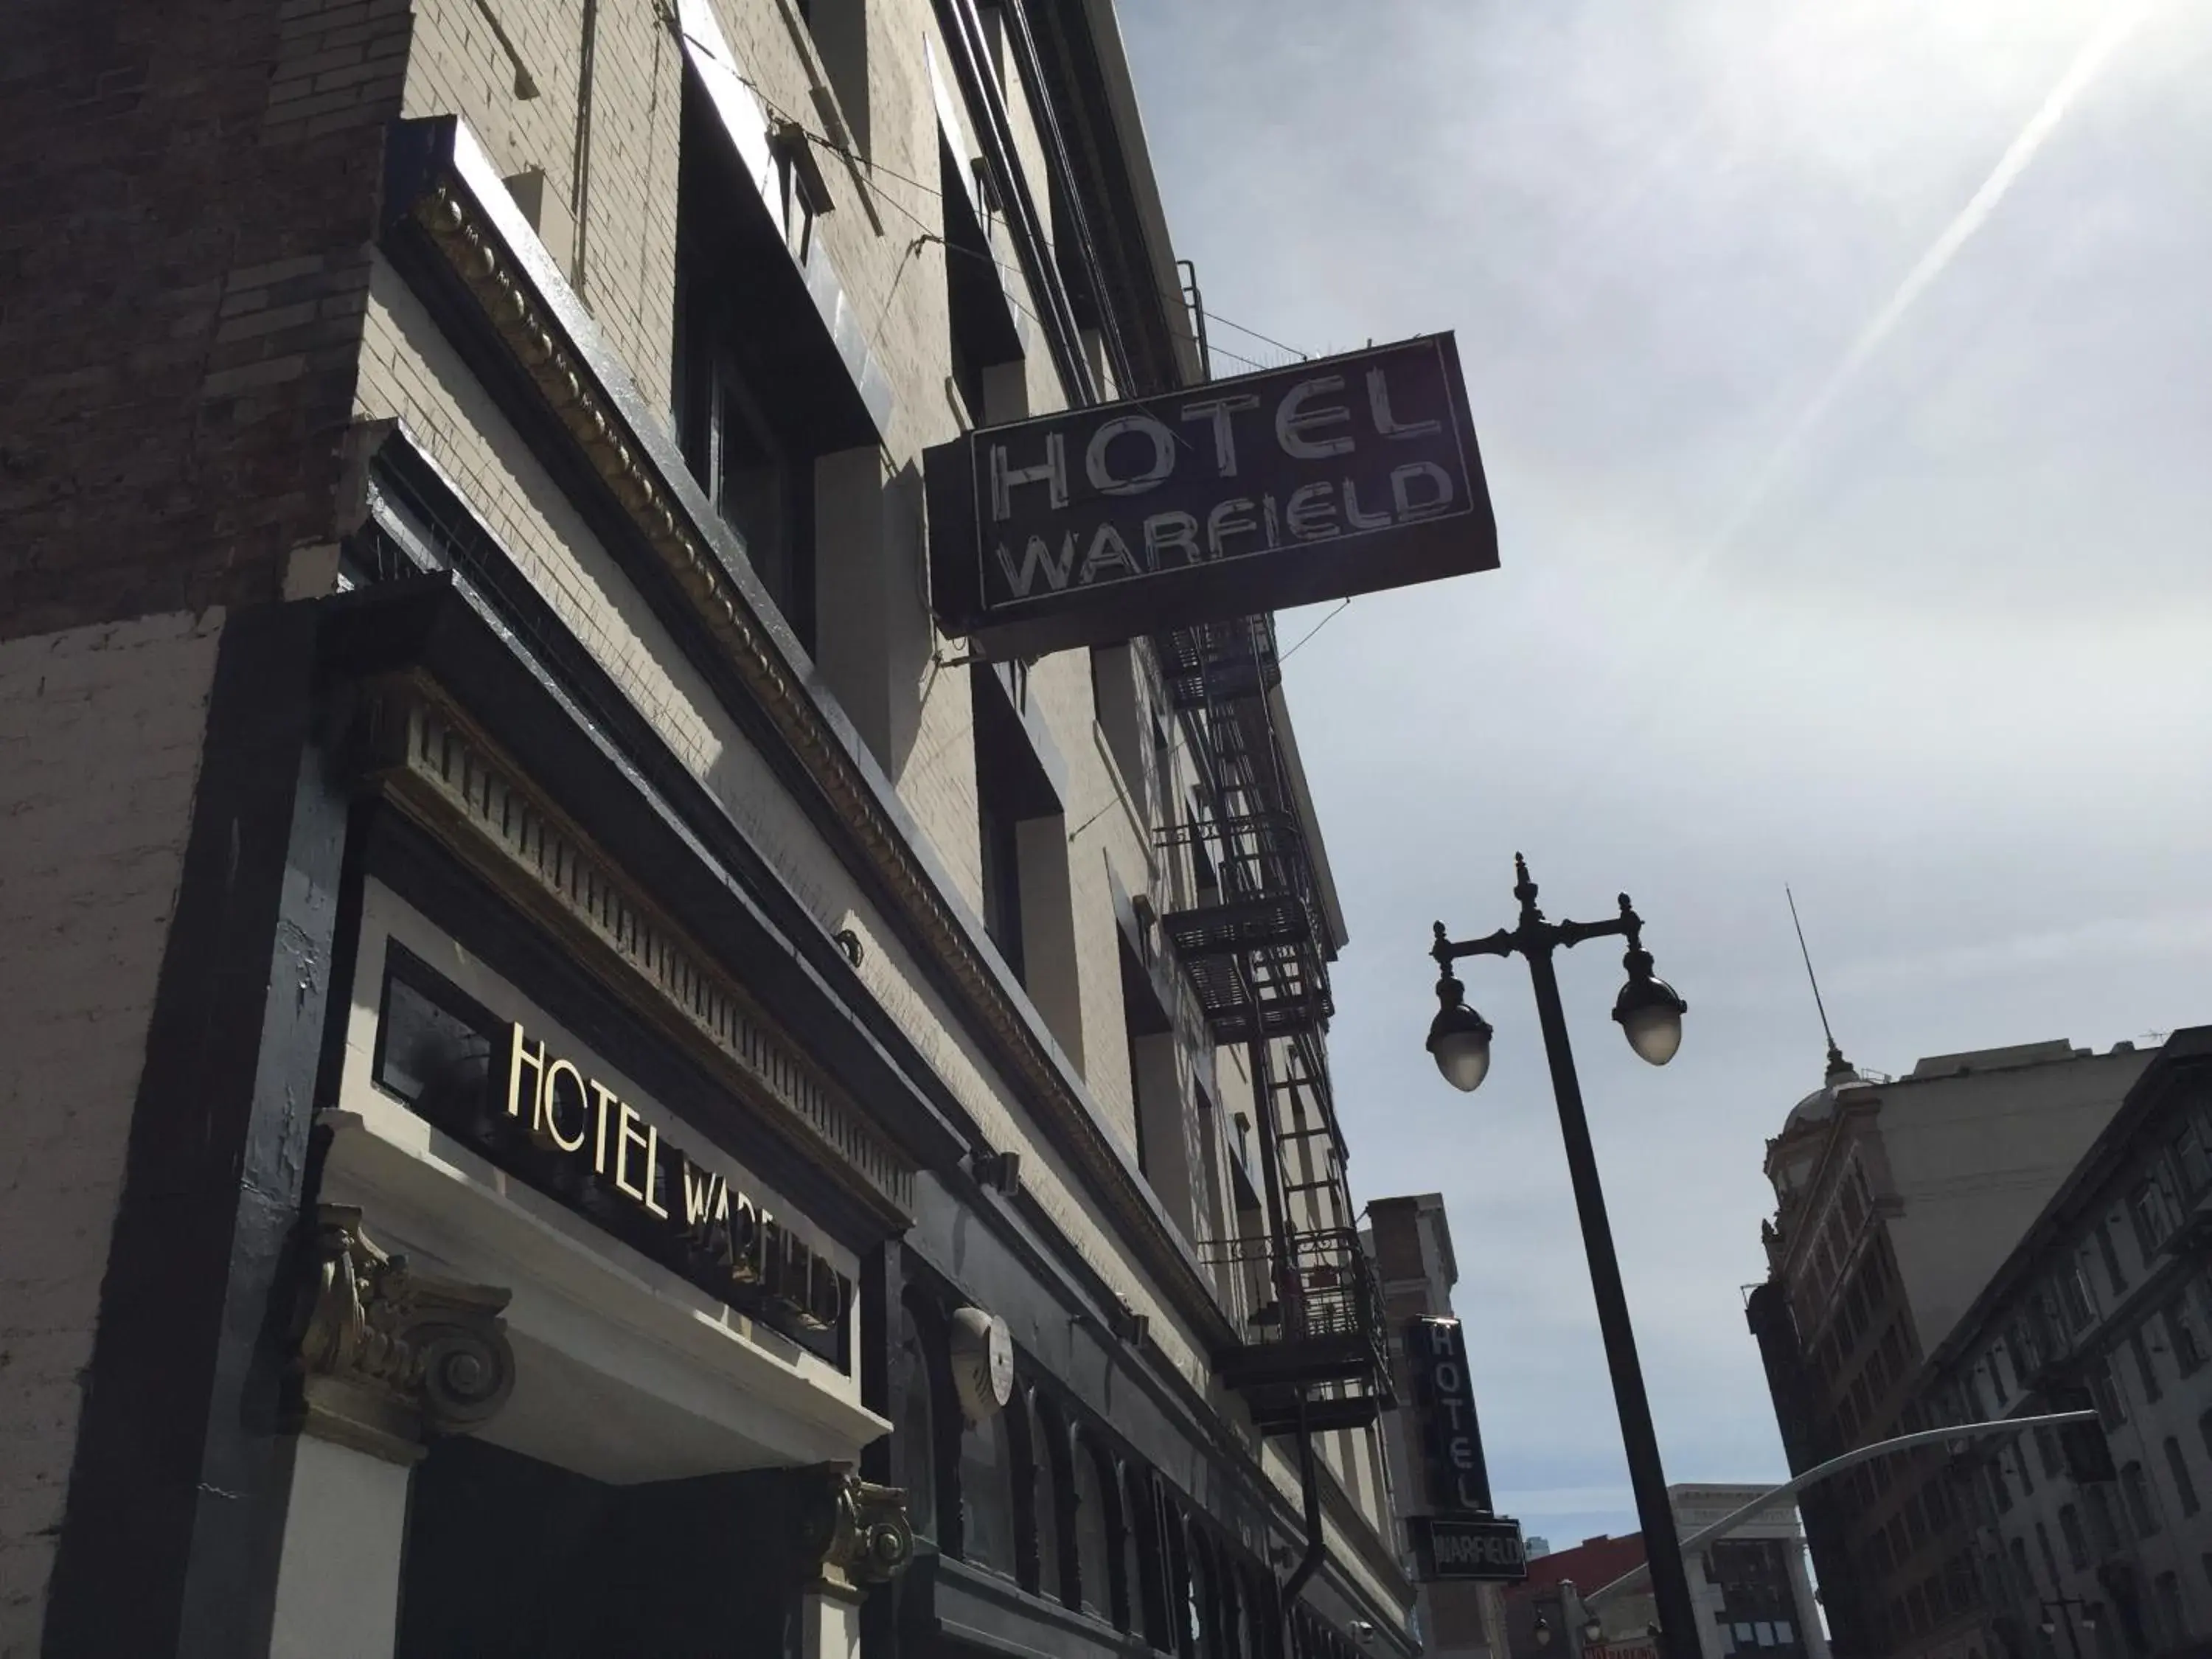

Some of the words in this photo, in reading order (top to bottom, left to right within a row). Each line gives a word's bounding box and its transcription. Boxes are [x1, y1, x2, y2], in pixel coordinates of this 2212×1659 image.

[989, 365, 1442, 522] HOTEL
[995, 460, 1455, 598] WARFIELD
[507, 1021, 669, 1220] HOTEL
[1430, 1324, 1480, 1509] HOTEL
